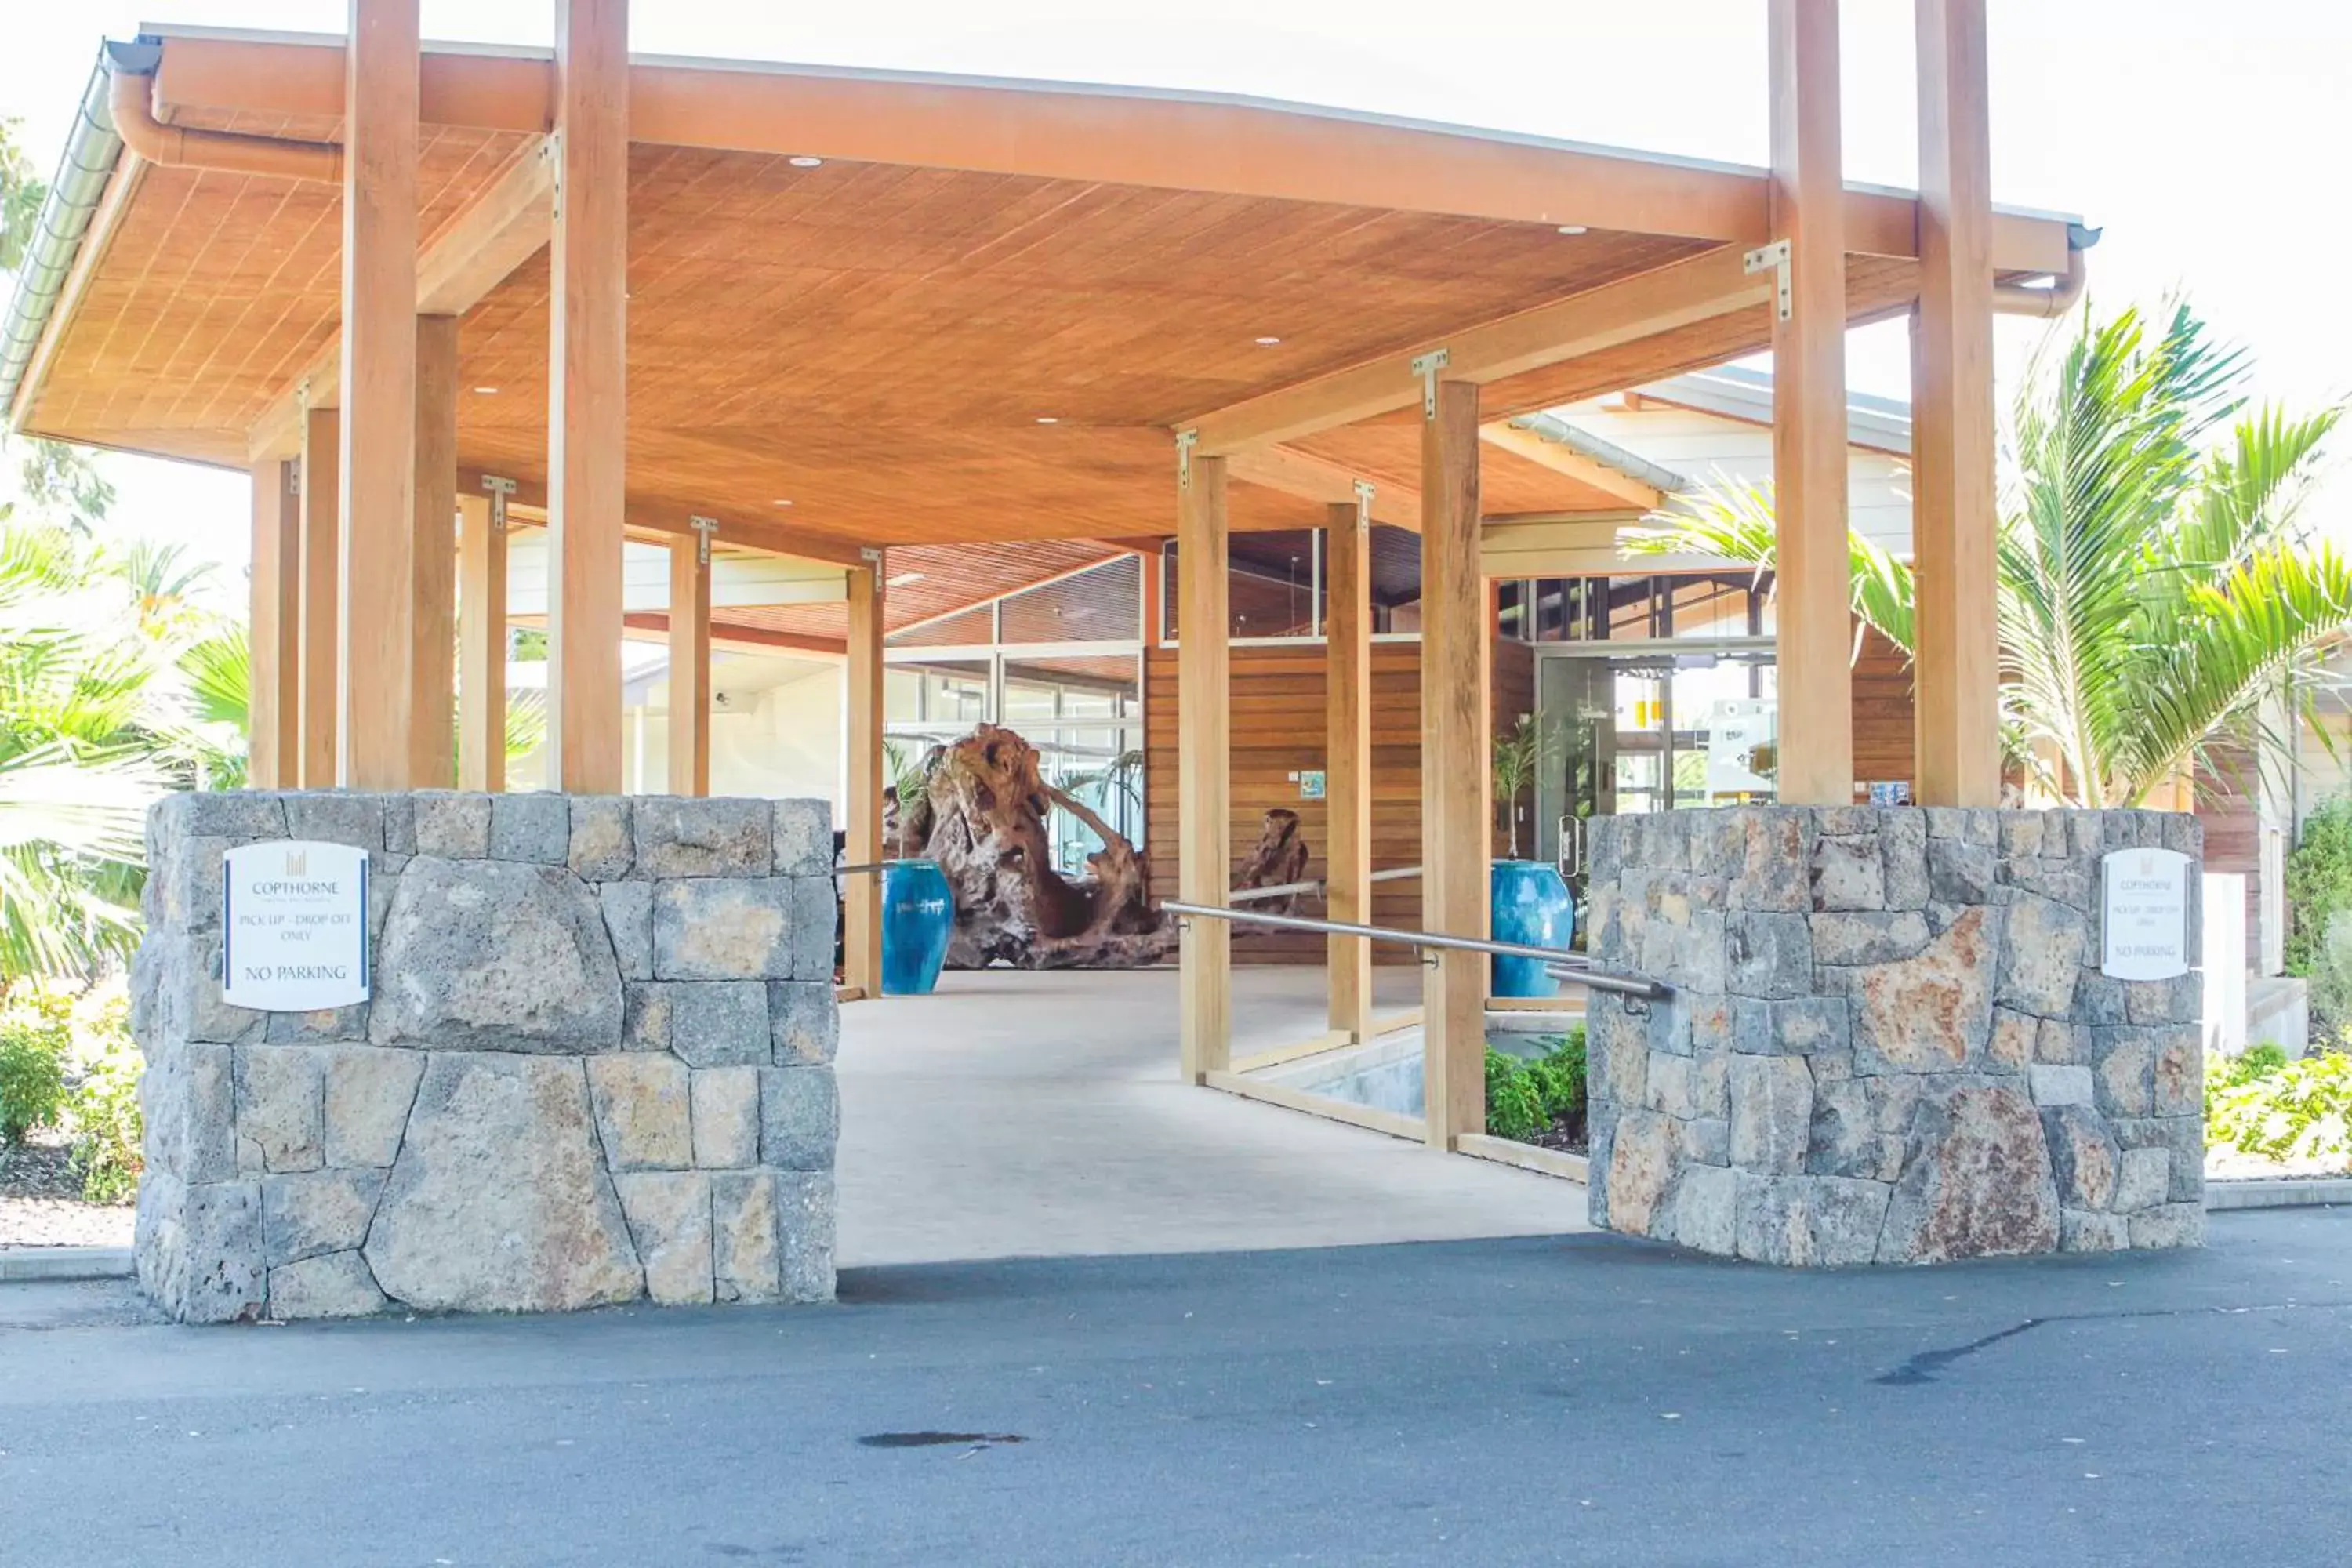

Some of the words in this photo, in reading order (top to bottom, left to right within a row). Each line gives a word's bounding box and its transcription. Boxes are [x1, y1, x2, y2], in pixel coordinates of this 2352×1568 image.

[252, 881, 339, 895] COPTHORNE
[239, 913, 265, 925] PICK
[269, 914, 285, 925] UP
[296, 914, 328, 925] DROP
[330, 913, 351, 924] OFF
[281, 930, 311, 942] ONLY
[245, 966, 272, 981] NO
[277, 965, 347, 979] PARKING
